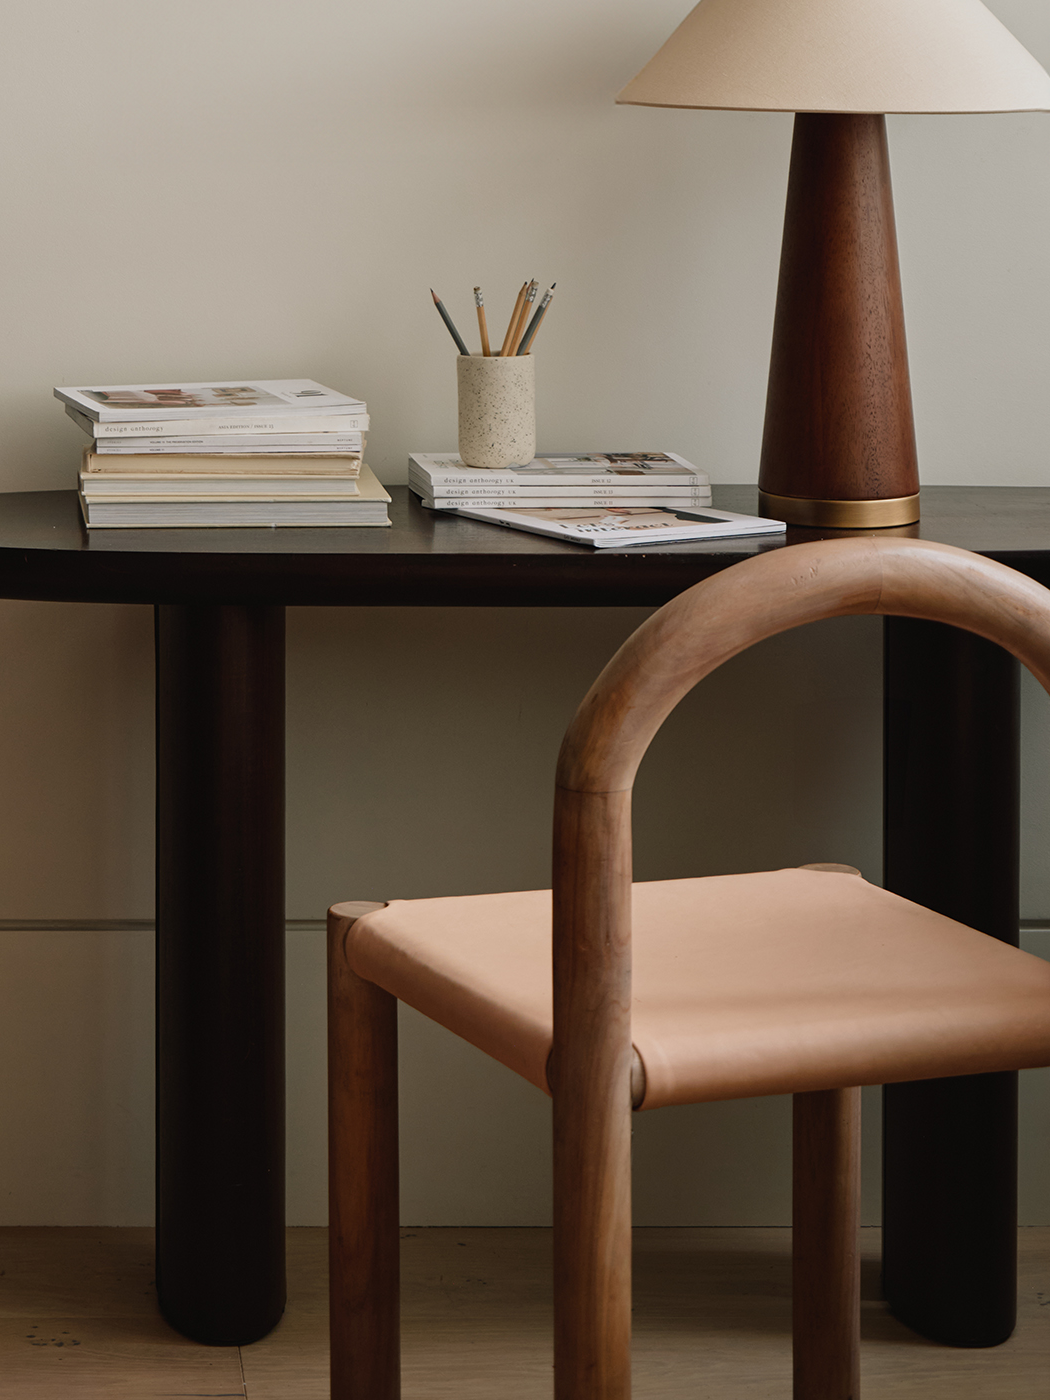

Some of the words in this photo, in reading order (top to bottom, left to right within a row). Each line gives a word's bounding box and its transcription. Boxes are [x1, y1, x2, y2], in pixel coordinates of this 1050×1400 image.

[105, 425, 127, 433] design
[444, 477, 467, 485] design
[469, 477, 503, 485] anthology
[446, 488, 469, 496] design
[471, 488, 505, 496] anthology
